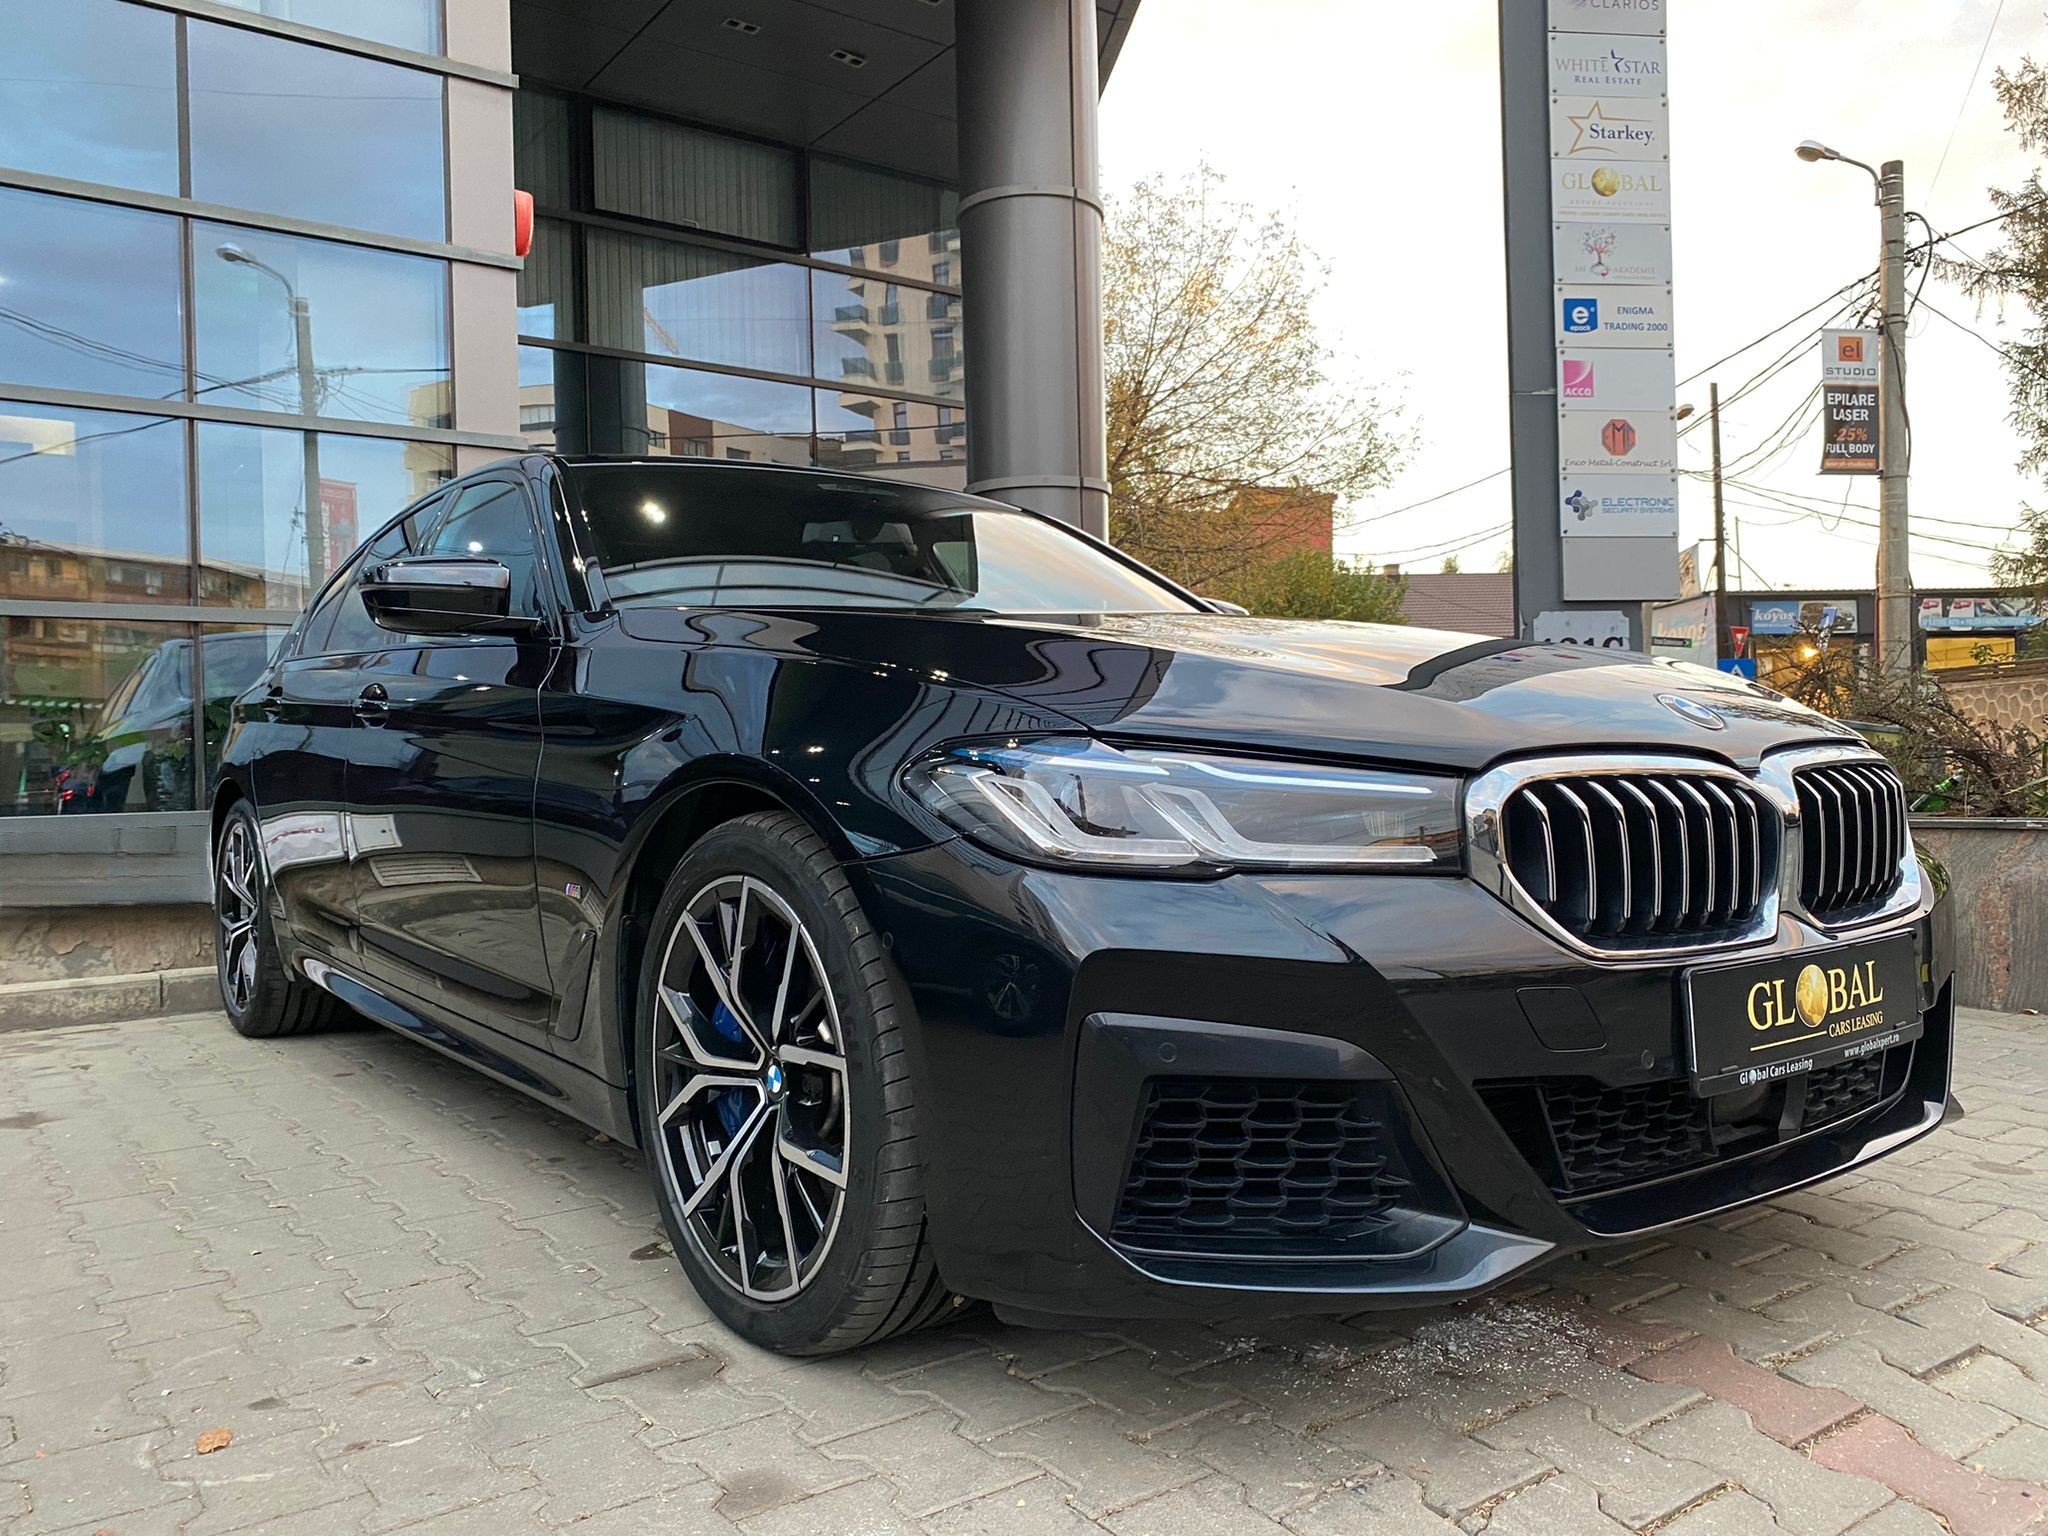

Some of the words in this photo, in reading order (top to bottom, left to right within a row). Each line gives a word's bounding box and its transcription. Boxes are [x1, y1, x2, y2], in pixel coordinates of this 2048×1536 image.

[1591, 0, 1659, 10] CLARIOS
[1555, 57, 1608, 72] WHITE
[1624, 60, 1662, 75] STAR
[1574, 75, 1600, 84] REAL
[1605, 76, 1641, 85] ESTATE
[1616, 306, 1654, 315] ENIGMA
[1604, 322, 1644, 331] TRADING
[1646, 323, 1668, 331] 2000
[1825, 367, 1876, 376] STUDIO
[1565, 388, 1592, 396] ACCO
[1827, 392, 1876, 406] EPILARE
[1833, 408, 1869, 421] LASER
[1826, 443, 1847, 453] FULL
[1849, 444, 1876, 453] BODY
[1564, 458, 1586, 466] Enco
[1588, 458, 1614, 467] Metal
[1615, 459, 1657, 467] Construct
[1602, 497, 1675, 507] ELECTRONIC
[1755, 608, 1795, 623] koyos
[1747, 960, 1884, 1031] GLOBAL
[1829, 1021, 1851, 1038] CARS
[1852, 1010, 1883, 1032] LEASING
[1844, 1033, 1900, 1059] www.globalxpert.ro
[1770, 1064, 1786, 1077] Cars
[1786, 1059, 1813, 1074] Leasing
